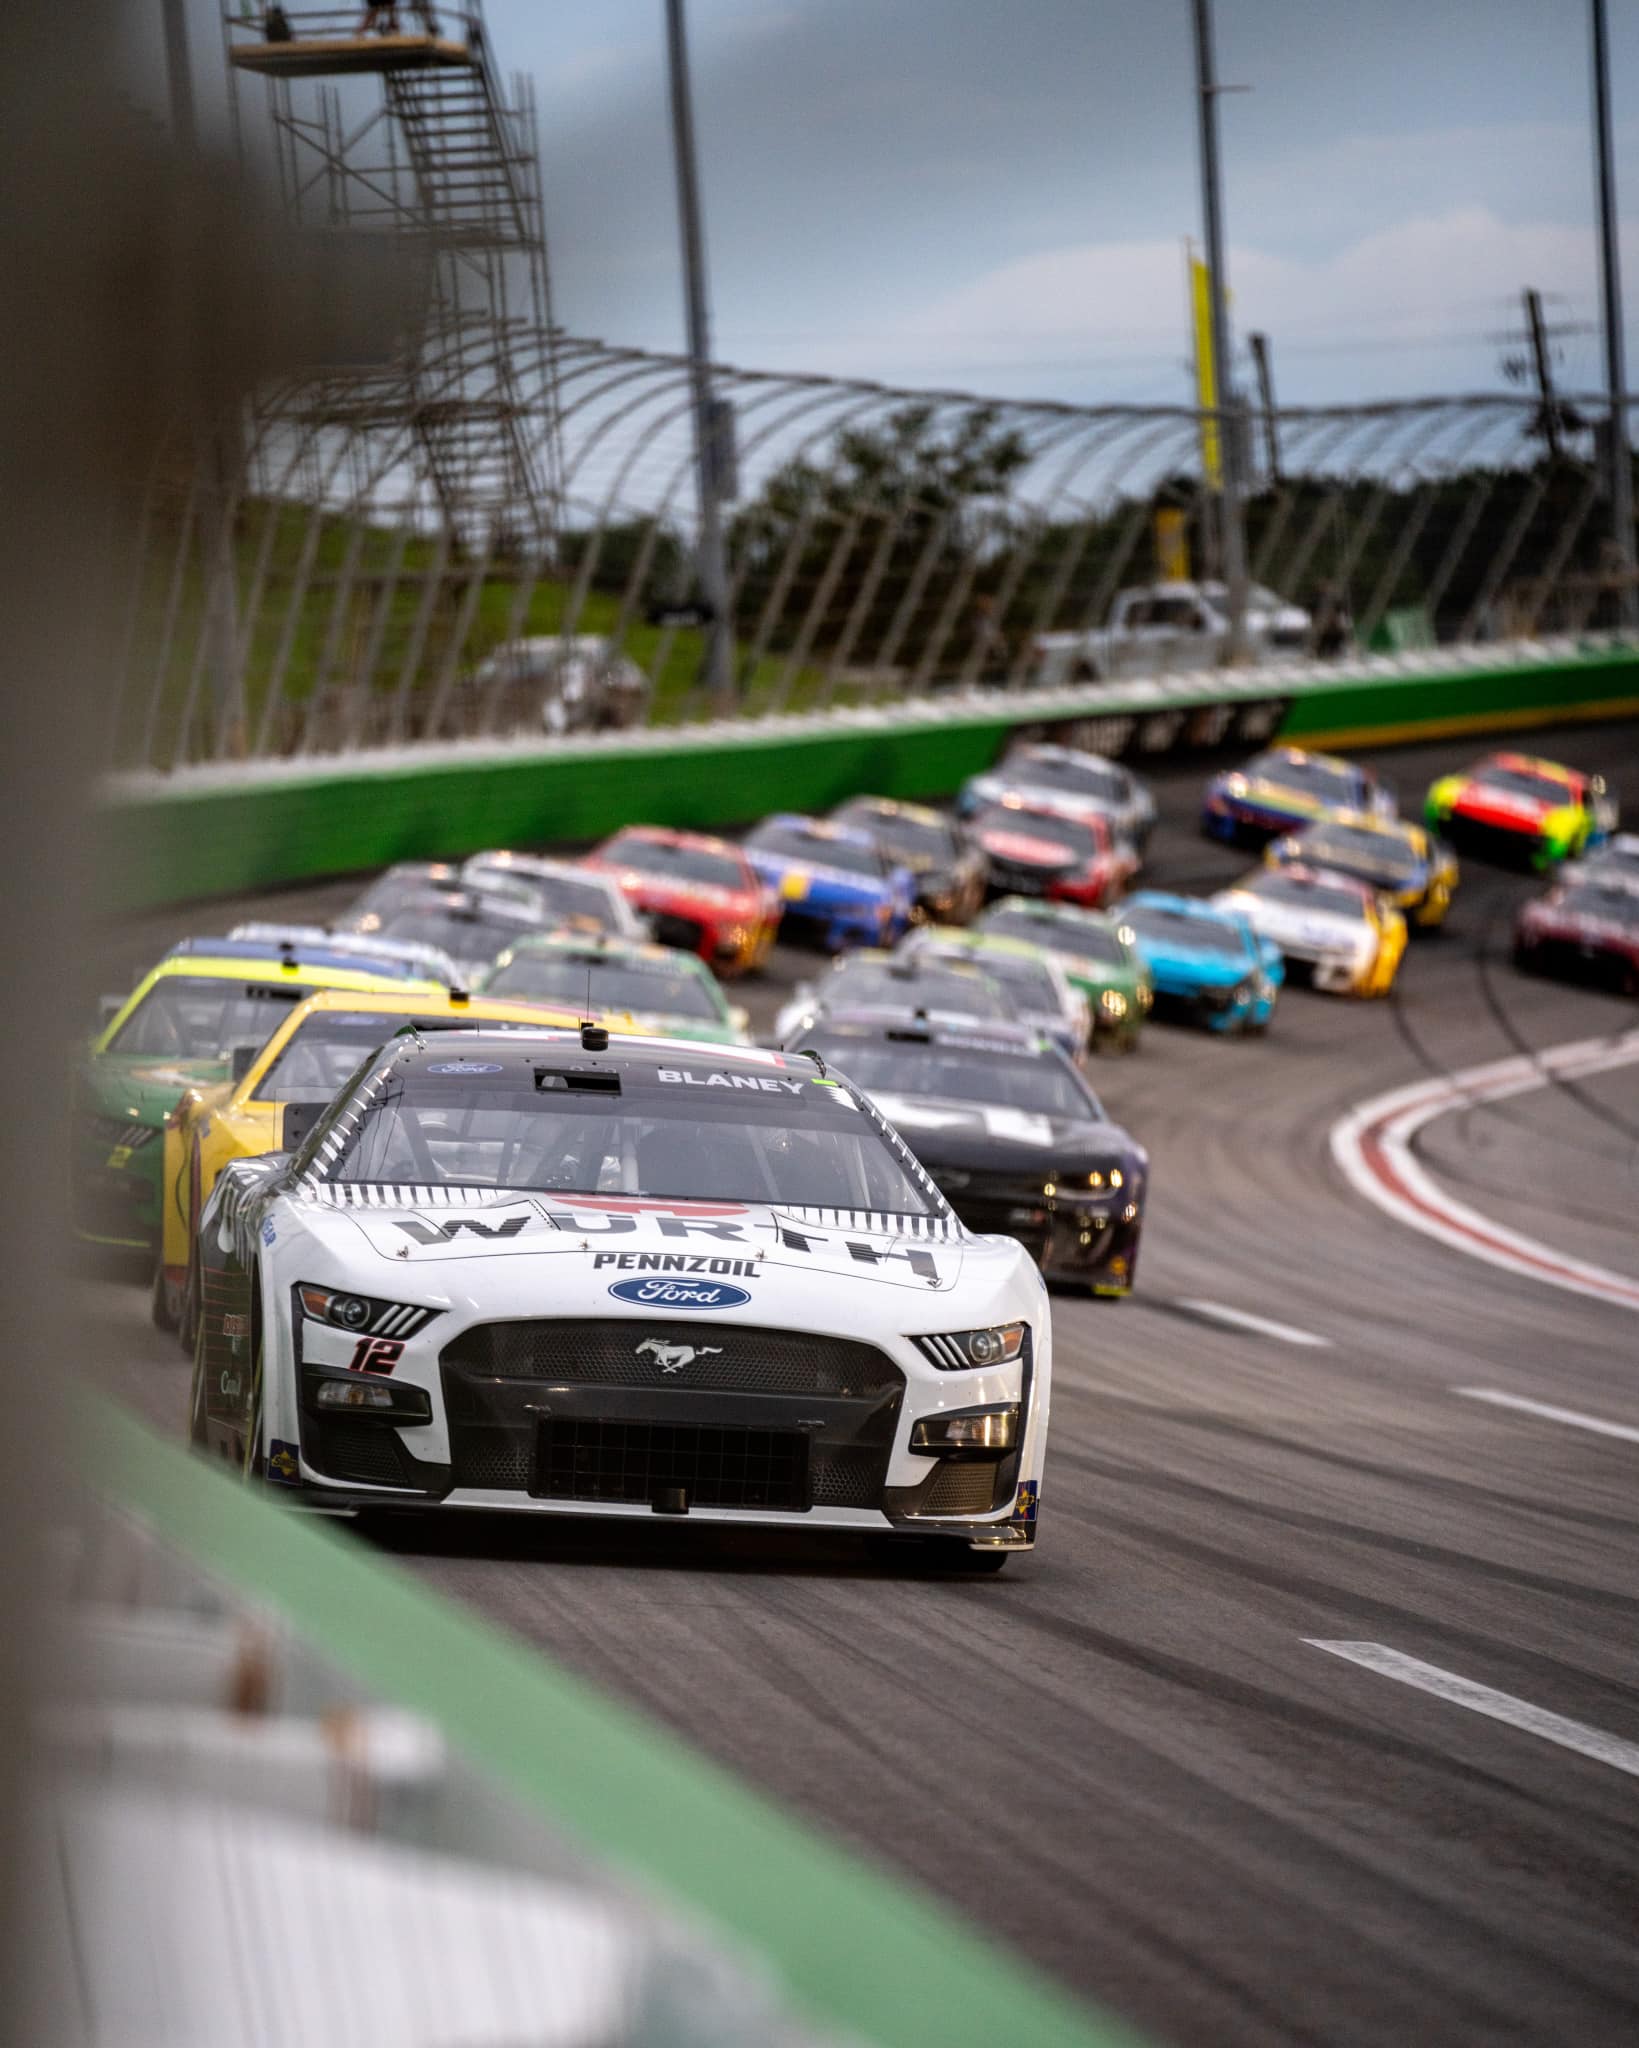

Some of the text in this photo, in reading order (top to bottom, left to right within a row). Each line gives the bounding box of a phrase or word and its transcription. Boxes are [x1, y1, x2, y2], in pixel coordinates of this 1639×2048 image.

[657, 1069, 804, 1095] BLANEY
[593, 1253, 761, 1278] PENNZOIL
[637, 1280, 720, 1303] Ford
[348, 1337, 406, 1376] 12
